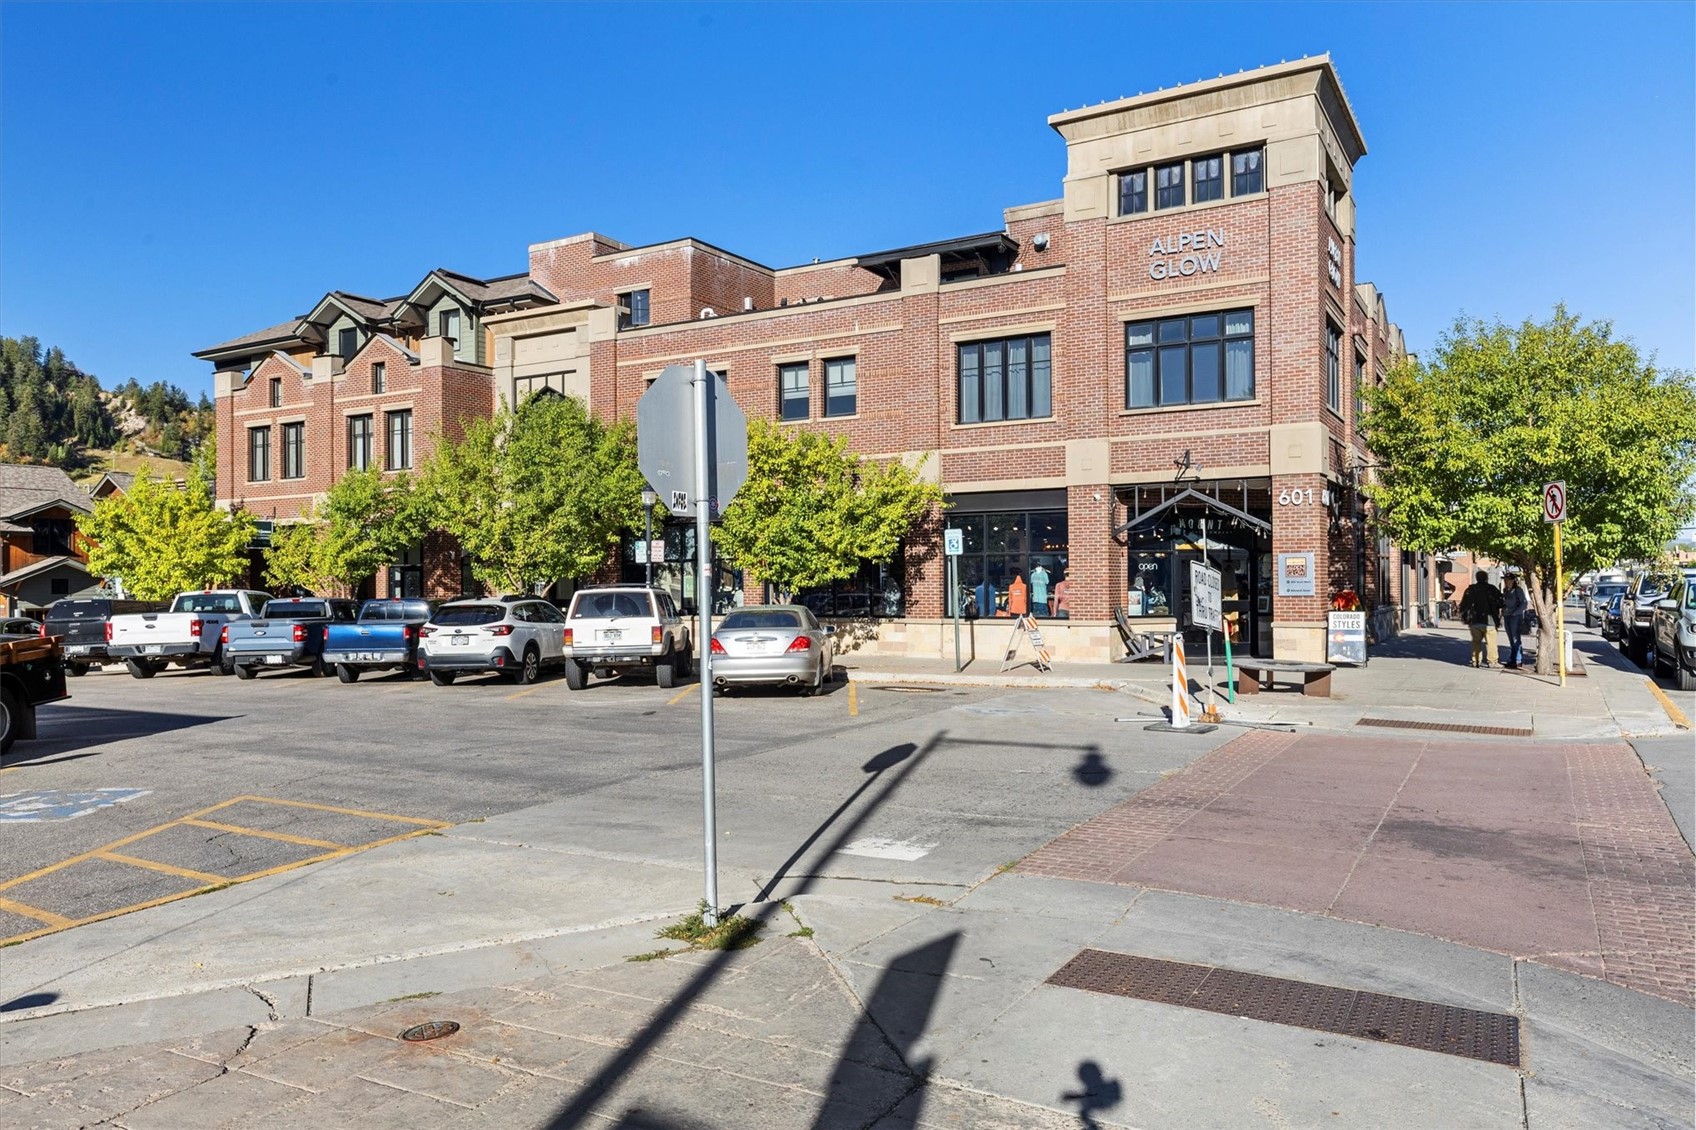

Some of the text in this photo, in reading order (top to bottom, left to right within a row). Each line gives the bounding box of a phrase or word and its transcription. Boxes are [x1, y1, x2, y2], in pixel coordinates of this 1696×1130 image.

[1149, 228, 1225, 257] ALPEN
[1149, 250, 1222, 280] GLOW
[1278, 488, 1313, 506] 601
[1138, 562, 1158, 572] open
[1195, 570, 1207, 586] ROAD
[1207, 591, 1212, 604] TO
[1196, 604, 1208, 620] THRU
[1333, 620, 1361, 629] STYLES
